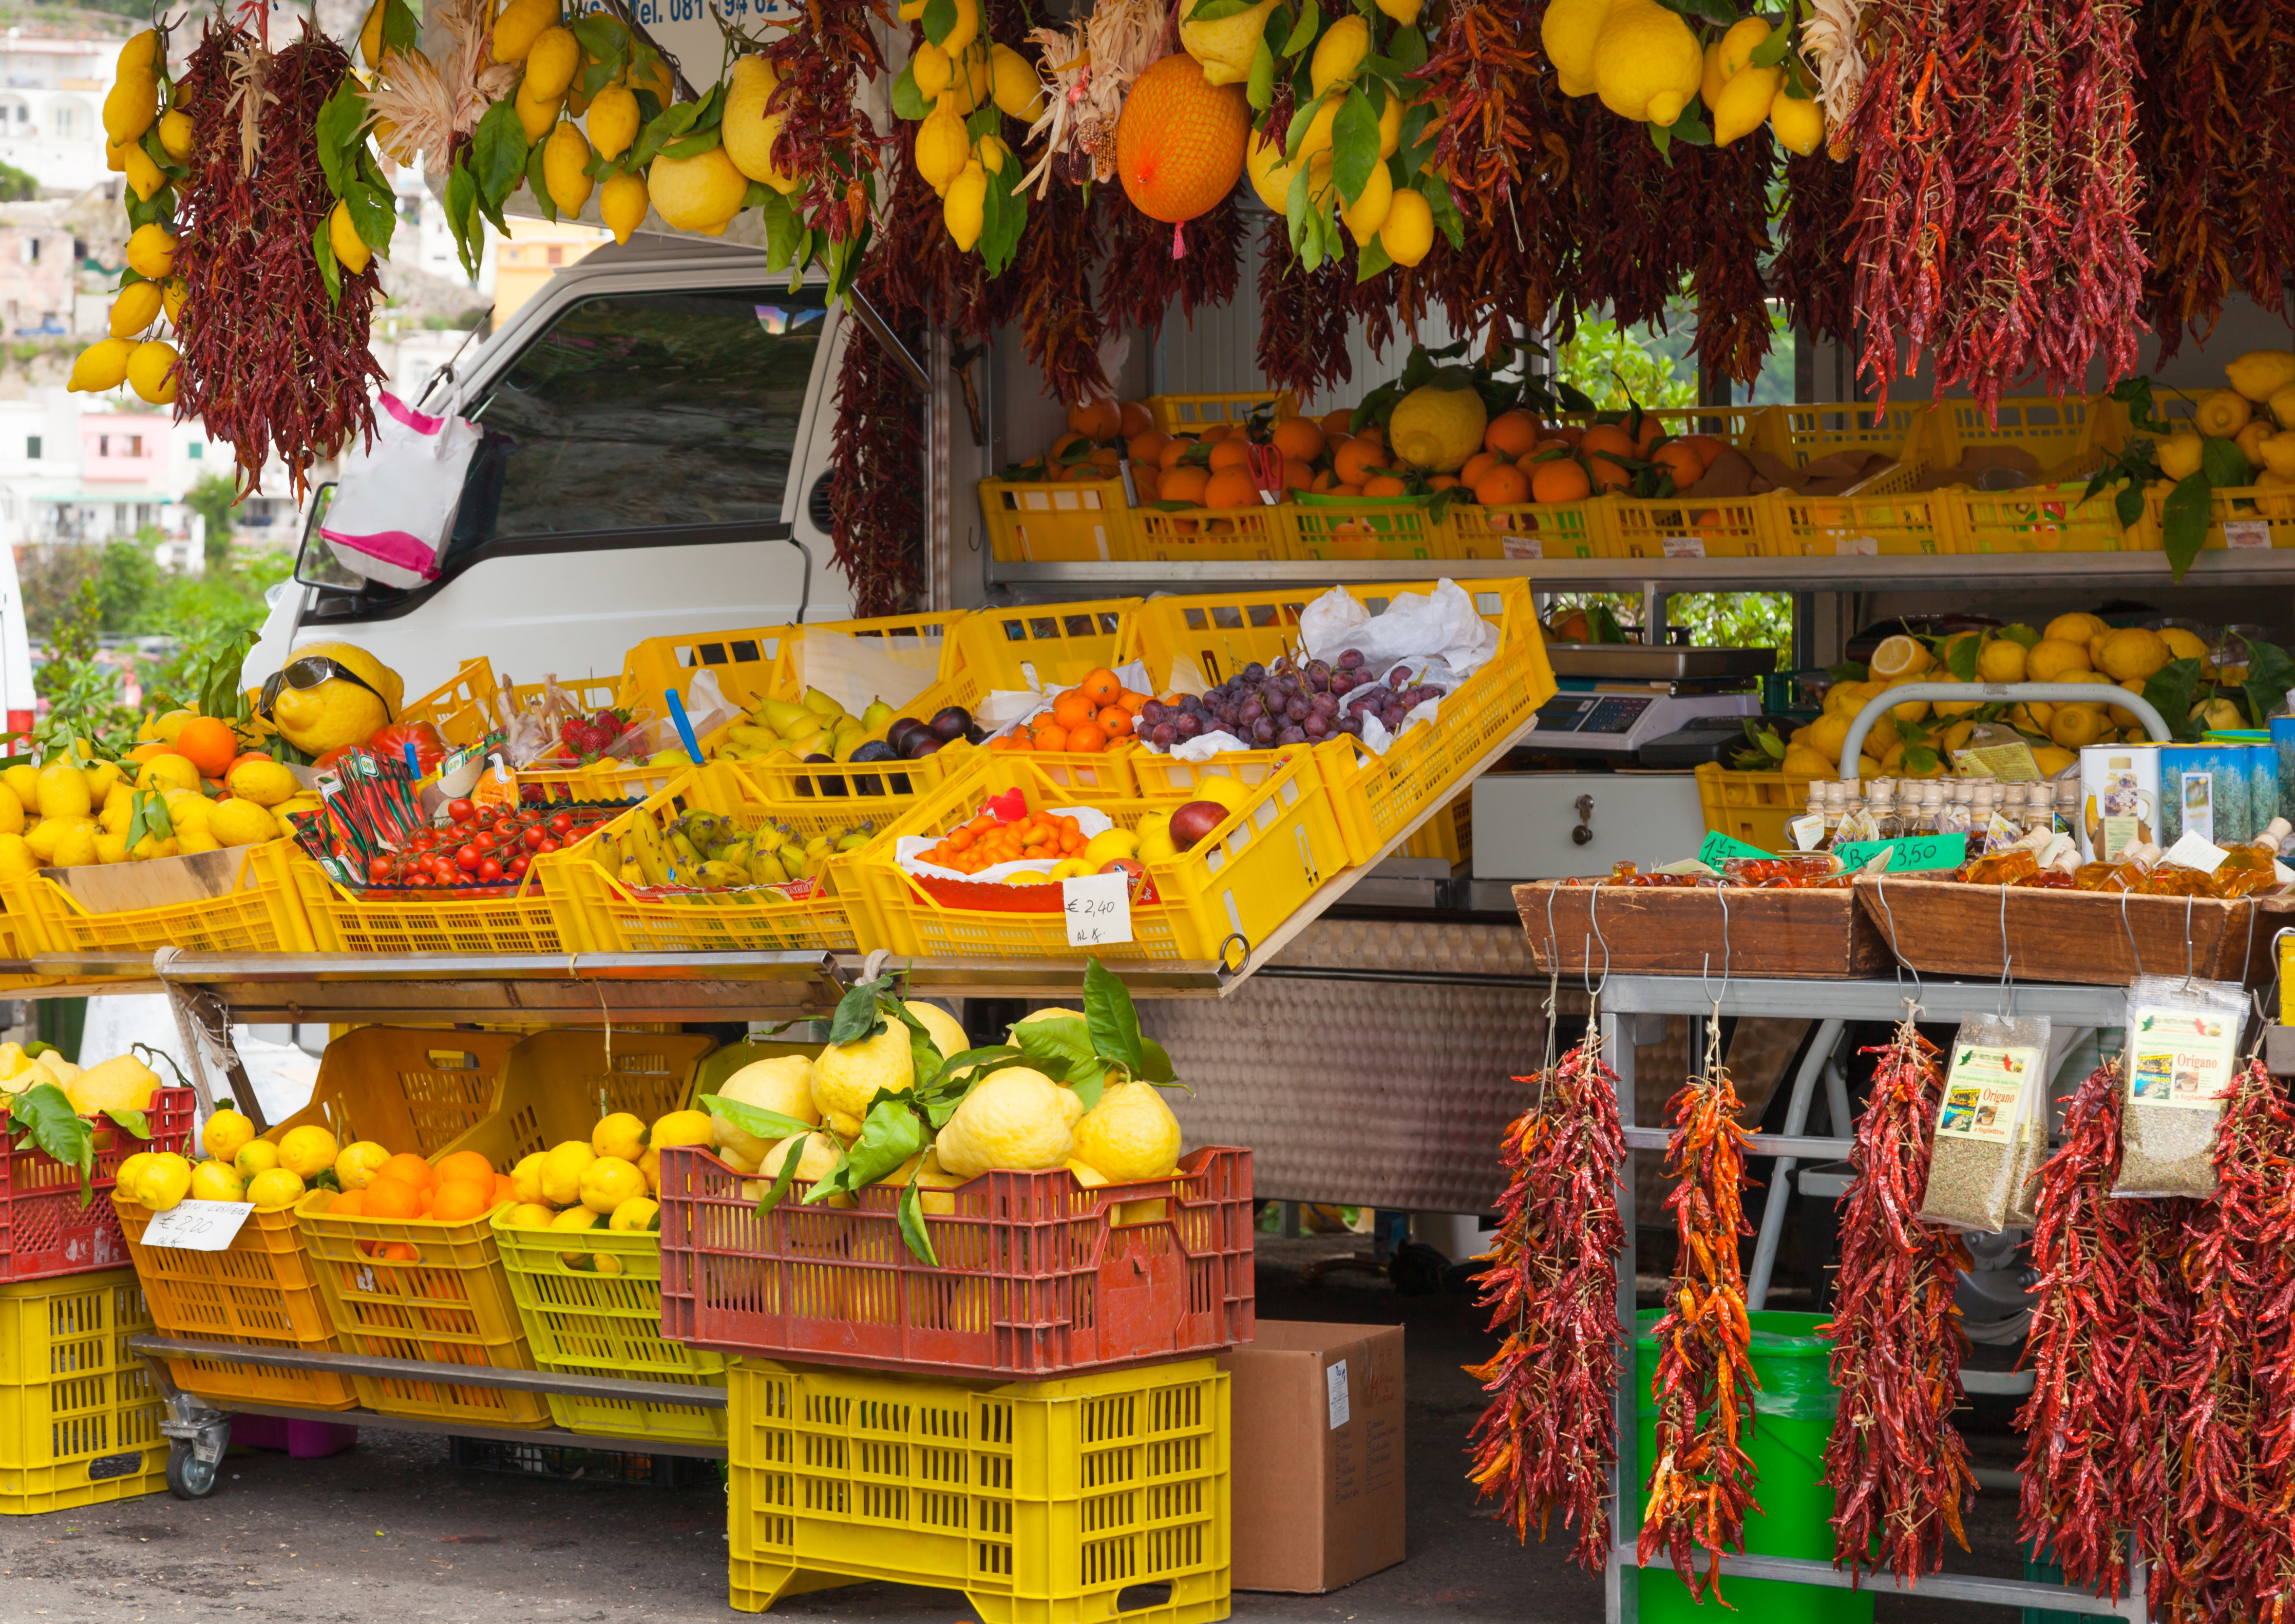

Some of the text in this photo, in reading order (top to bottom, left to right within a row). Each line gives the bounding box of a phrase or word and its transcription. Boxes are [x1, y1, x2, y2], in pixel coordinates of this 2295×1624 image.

[670, 0, 703, 22] 081
[1896, 842, 1937, 867] 3,50
[1065, 899, 1114, 917] € 2,40
[2177, 1053, 2217, 1071] Origano
[2137, 1073, 2170, 1083] Positano
[1983, 1087, 2015, 1105] Origano
[1947, 1106, 1975, 1116] Positano
[1978, 1127, 2005, 1136] fogliettine
[158, 1214, 213, 1234] € 2,20
